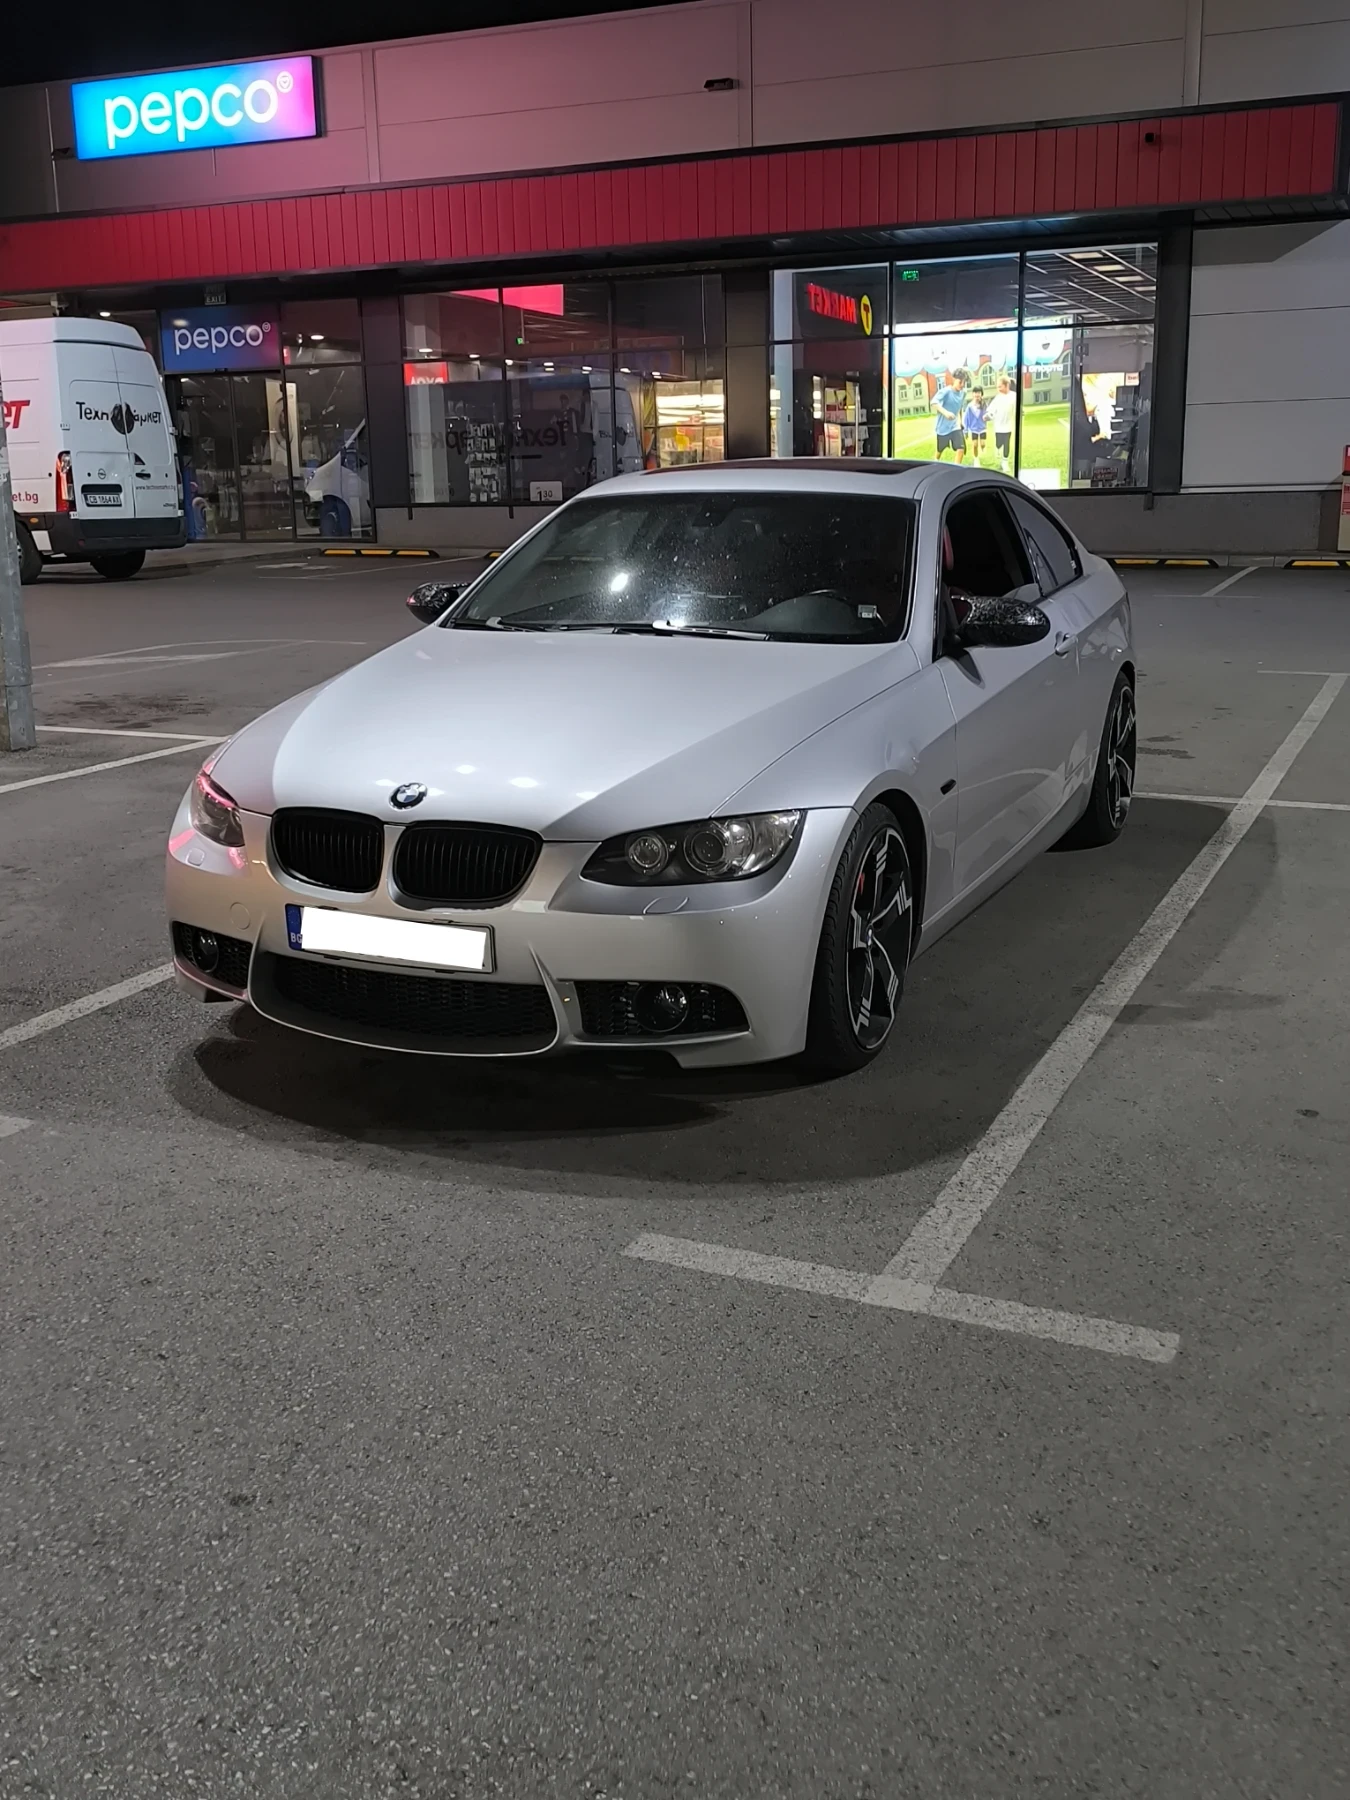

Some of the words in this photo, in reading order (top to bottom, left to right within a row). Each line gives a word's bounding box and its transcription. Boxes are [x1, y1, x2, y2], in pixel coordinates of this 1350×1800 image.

[104, 79, 278, 150] pepco
[206, 295, 222, 303] EXIT
[174, 324, 263, 355] pepco
